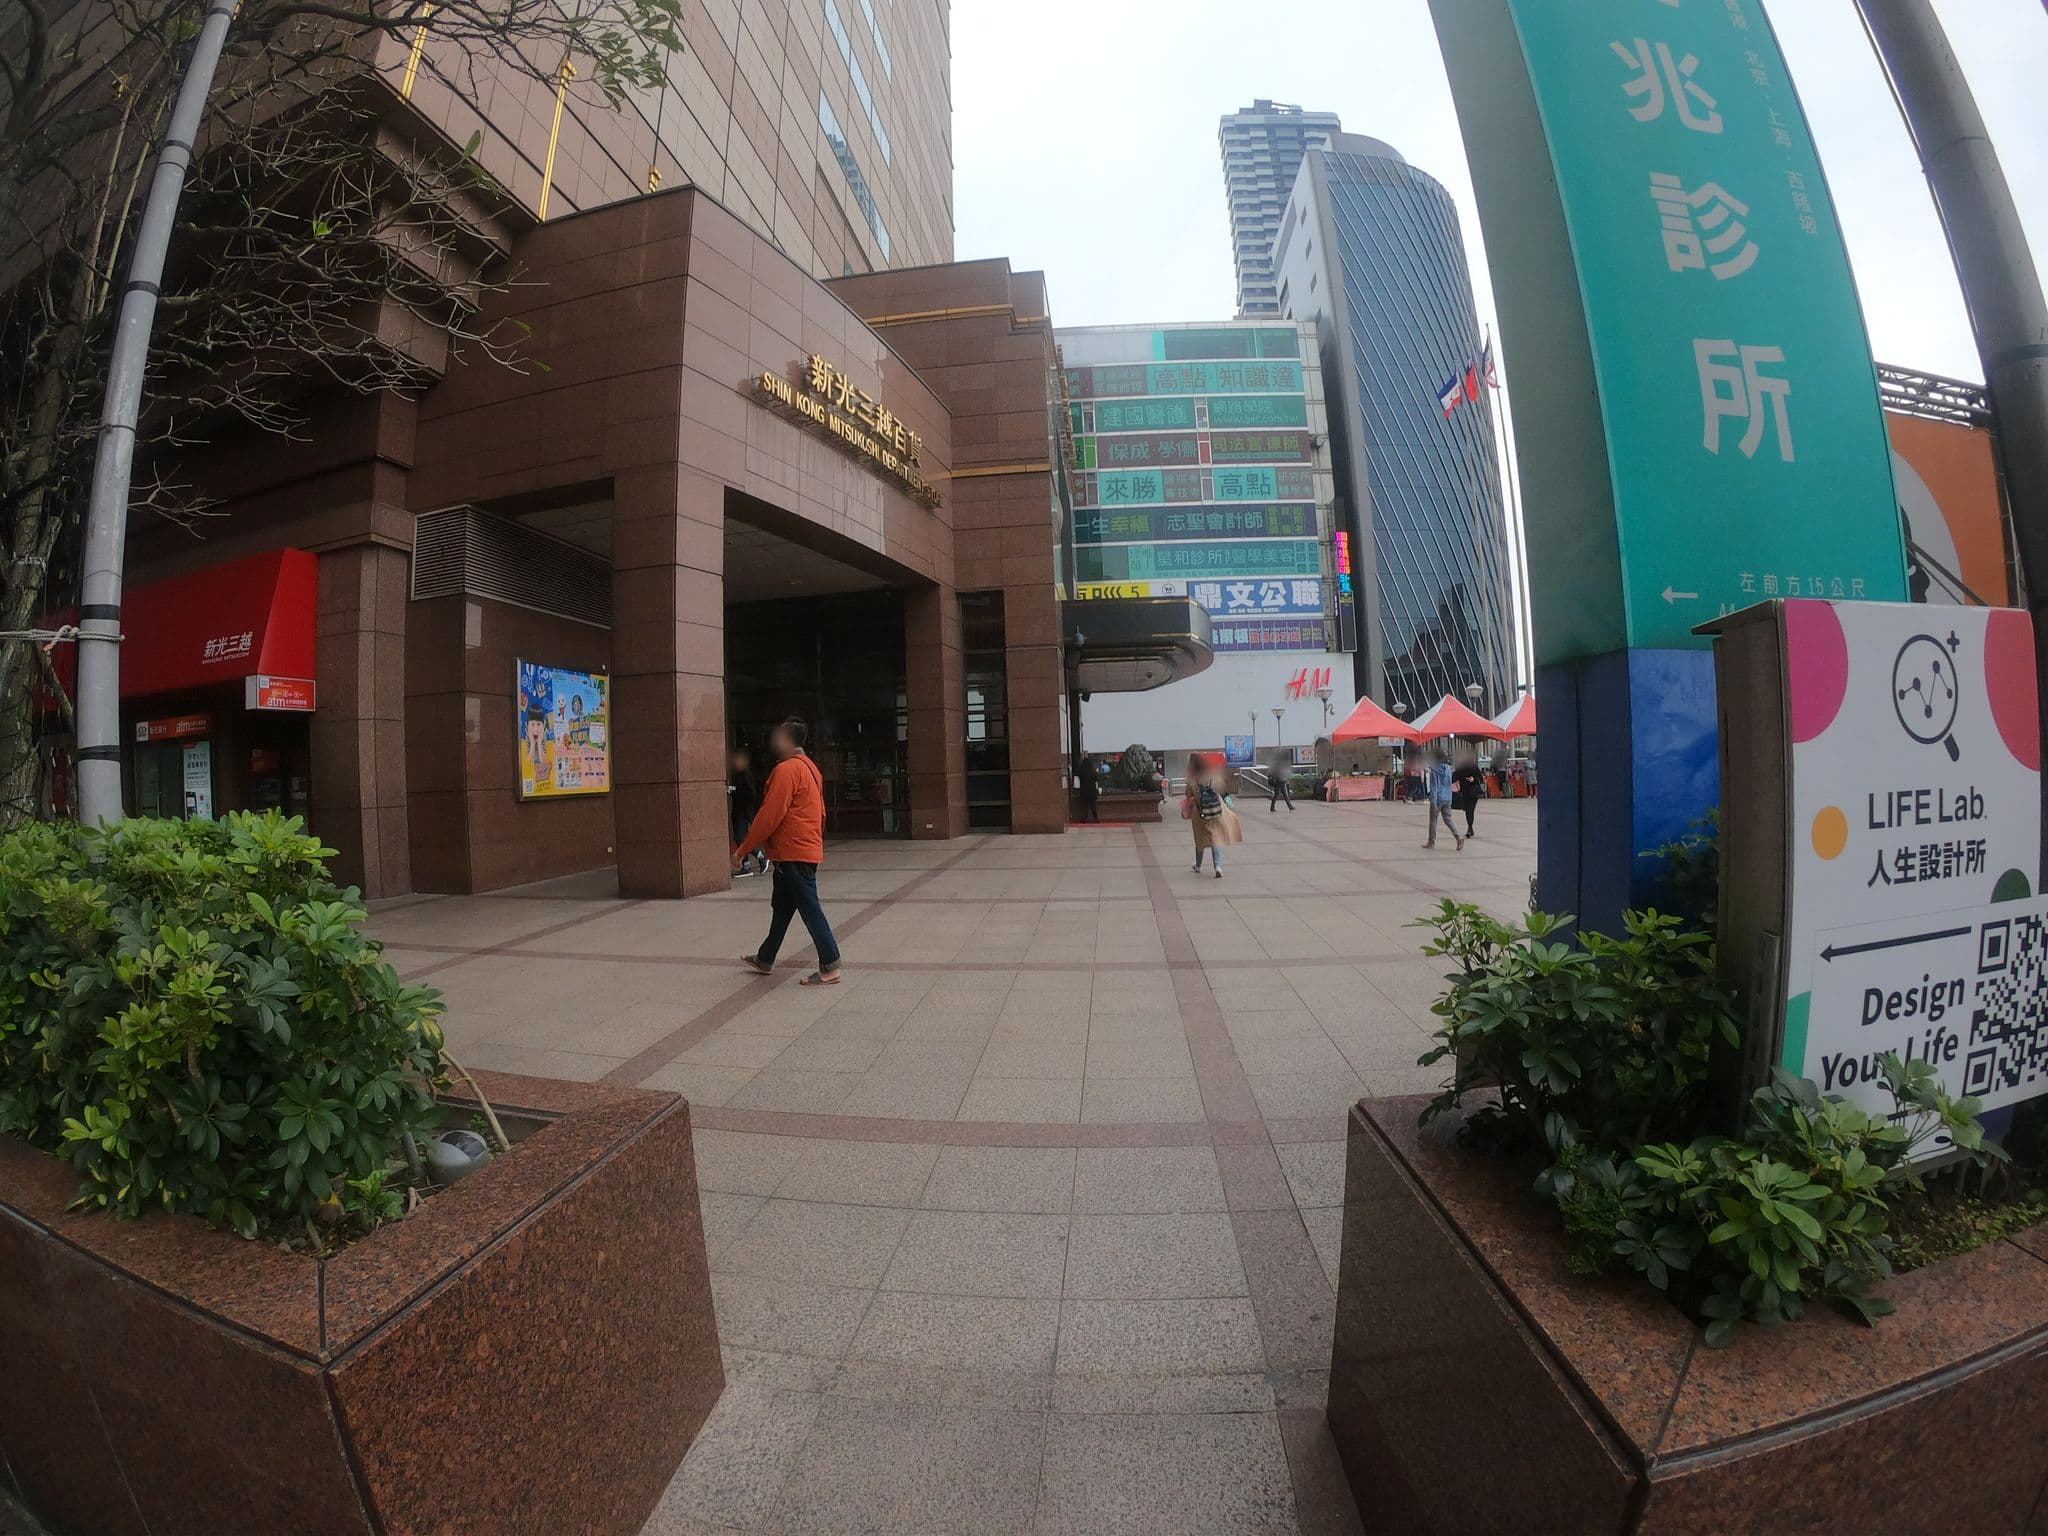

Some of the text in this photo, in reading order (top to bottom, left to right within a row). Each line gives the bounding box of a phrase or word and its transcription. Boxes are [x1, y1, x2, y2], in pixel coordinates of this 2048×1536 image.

[1609, 0, 1796, 463] 兆診所
[1156, 367, 1206, 392] 高點
[1219, 365, 1297, 390] 知識達
[763, 372, 792, 405] SHIN
[796, 392, 825, 425] KONG
[829, 413, 880, 461] MITSUKOSHI
[810, 354, 922, 468] 新光三越百貨
[1105, 475, 1157, 500] 來勝
[1219, 472, 1271, 497] 高點
[1167, 511, 1263, 531] 志聖會計師
[1194, 580, 1321, 609] 鼎文公職
[1739, 571, 1865, 598] 左前方15公尺
[203, 631, 253, 658] 新光三越
[1286, 666, 1332, 700] H&M
[267, 696, 285, 707] atm
[1868, 789, 1931, 829] LIFE
[1867, 838, 1986, 888] 人生設計所
[1861, 973, 1965, 1026] Design
